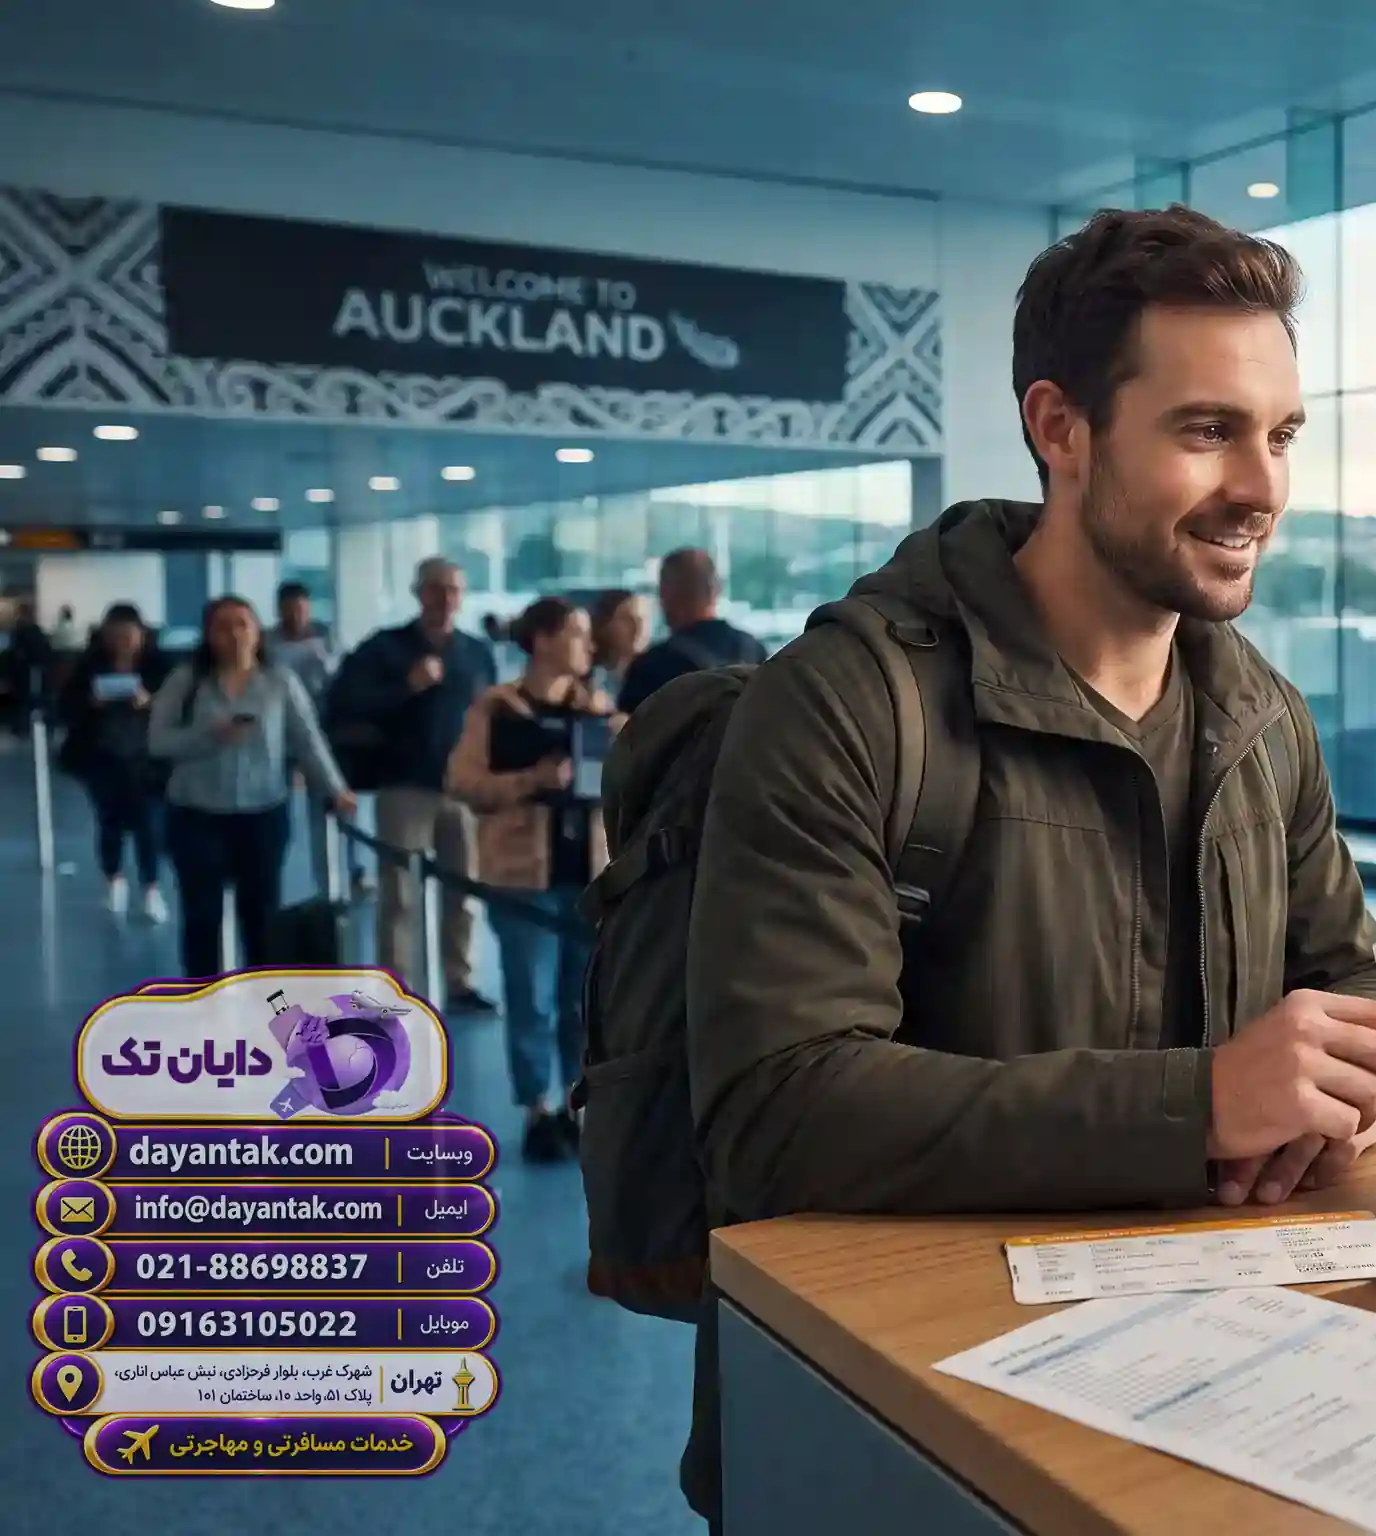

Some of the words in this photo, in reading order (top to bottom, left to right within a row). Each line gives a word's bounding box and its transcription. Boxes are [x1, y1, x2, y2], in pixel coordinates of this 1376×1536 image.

[423, 261, 584, 305] WELCOME
[596, 277, 637, 310] TO
[333, 287, 666, 362] AUCKLAND
